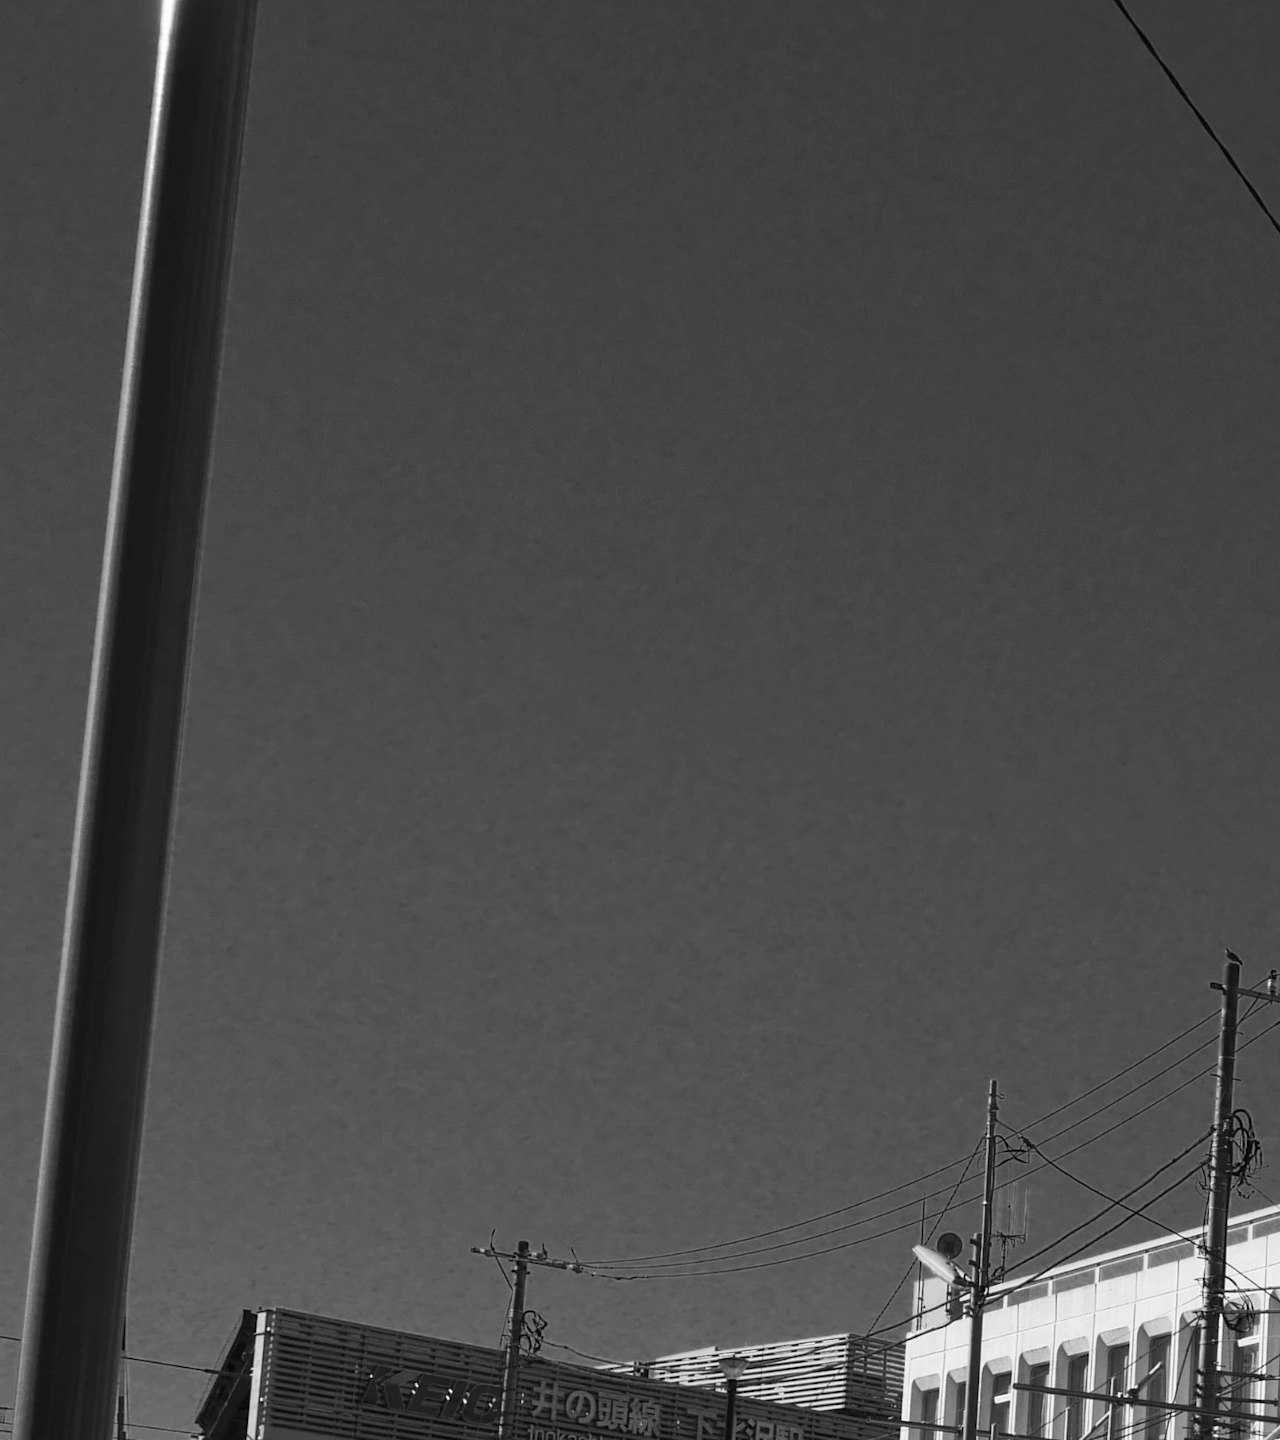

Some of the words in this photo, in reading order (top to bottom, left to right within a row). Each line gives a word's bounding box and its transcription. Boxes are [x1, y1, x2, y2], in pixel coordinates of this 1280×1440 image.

[361, 1364, 502, 1425] KEIO
[531, 1377, 662, 1438] 井の頭線
